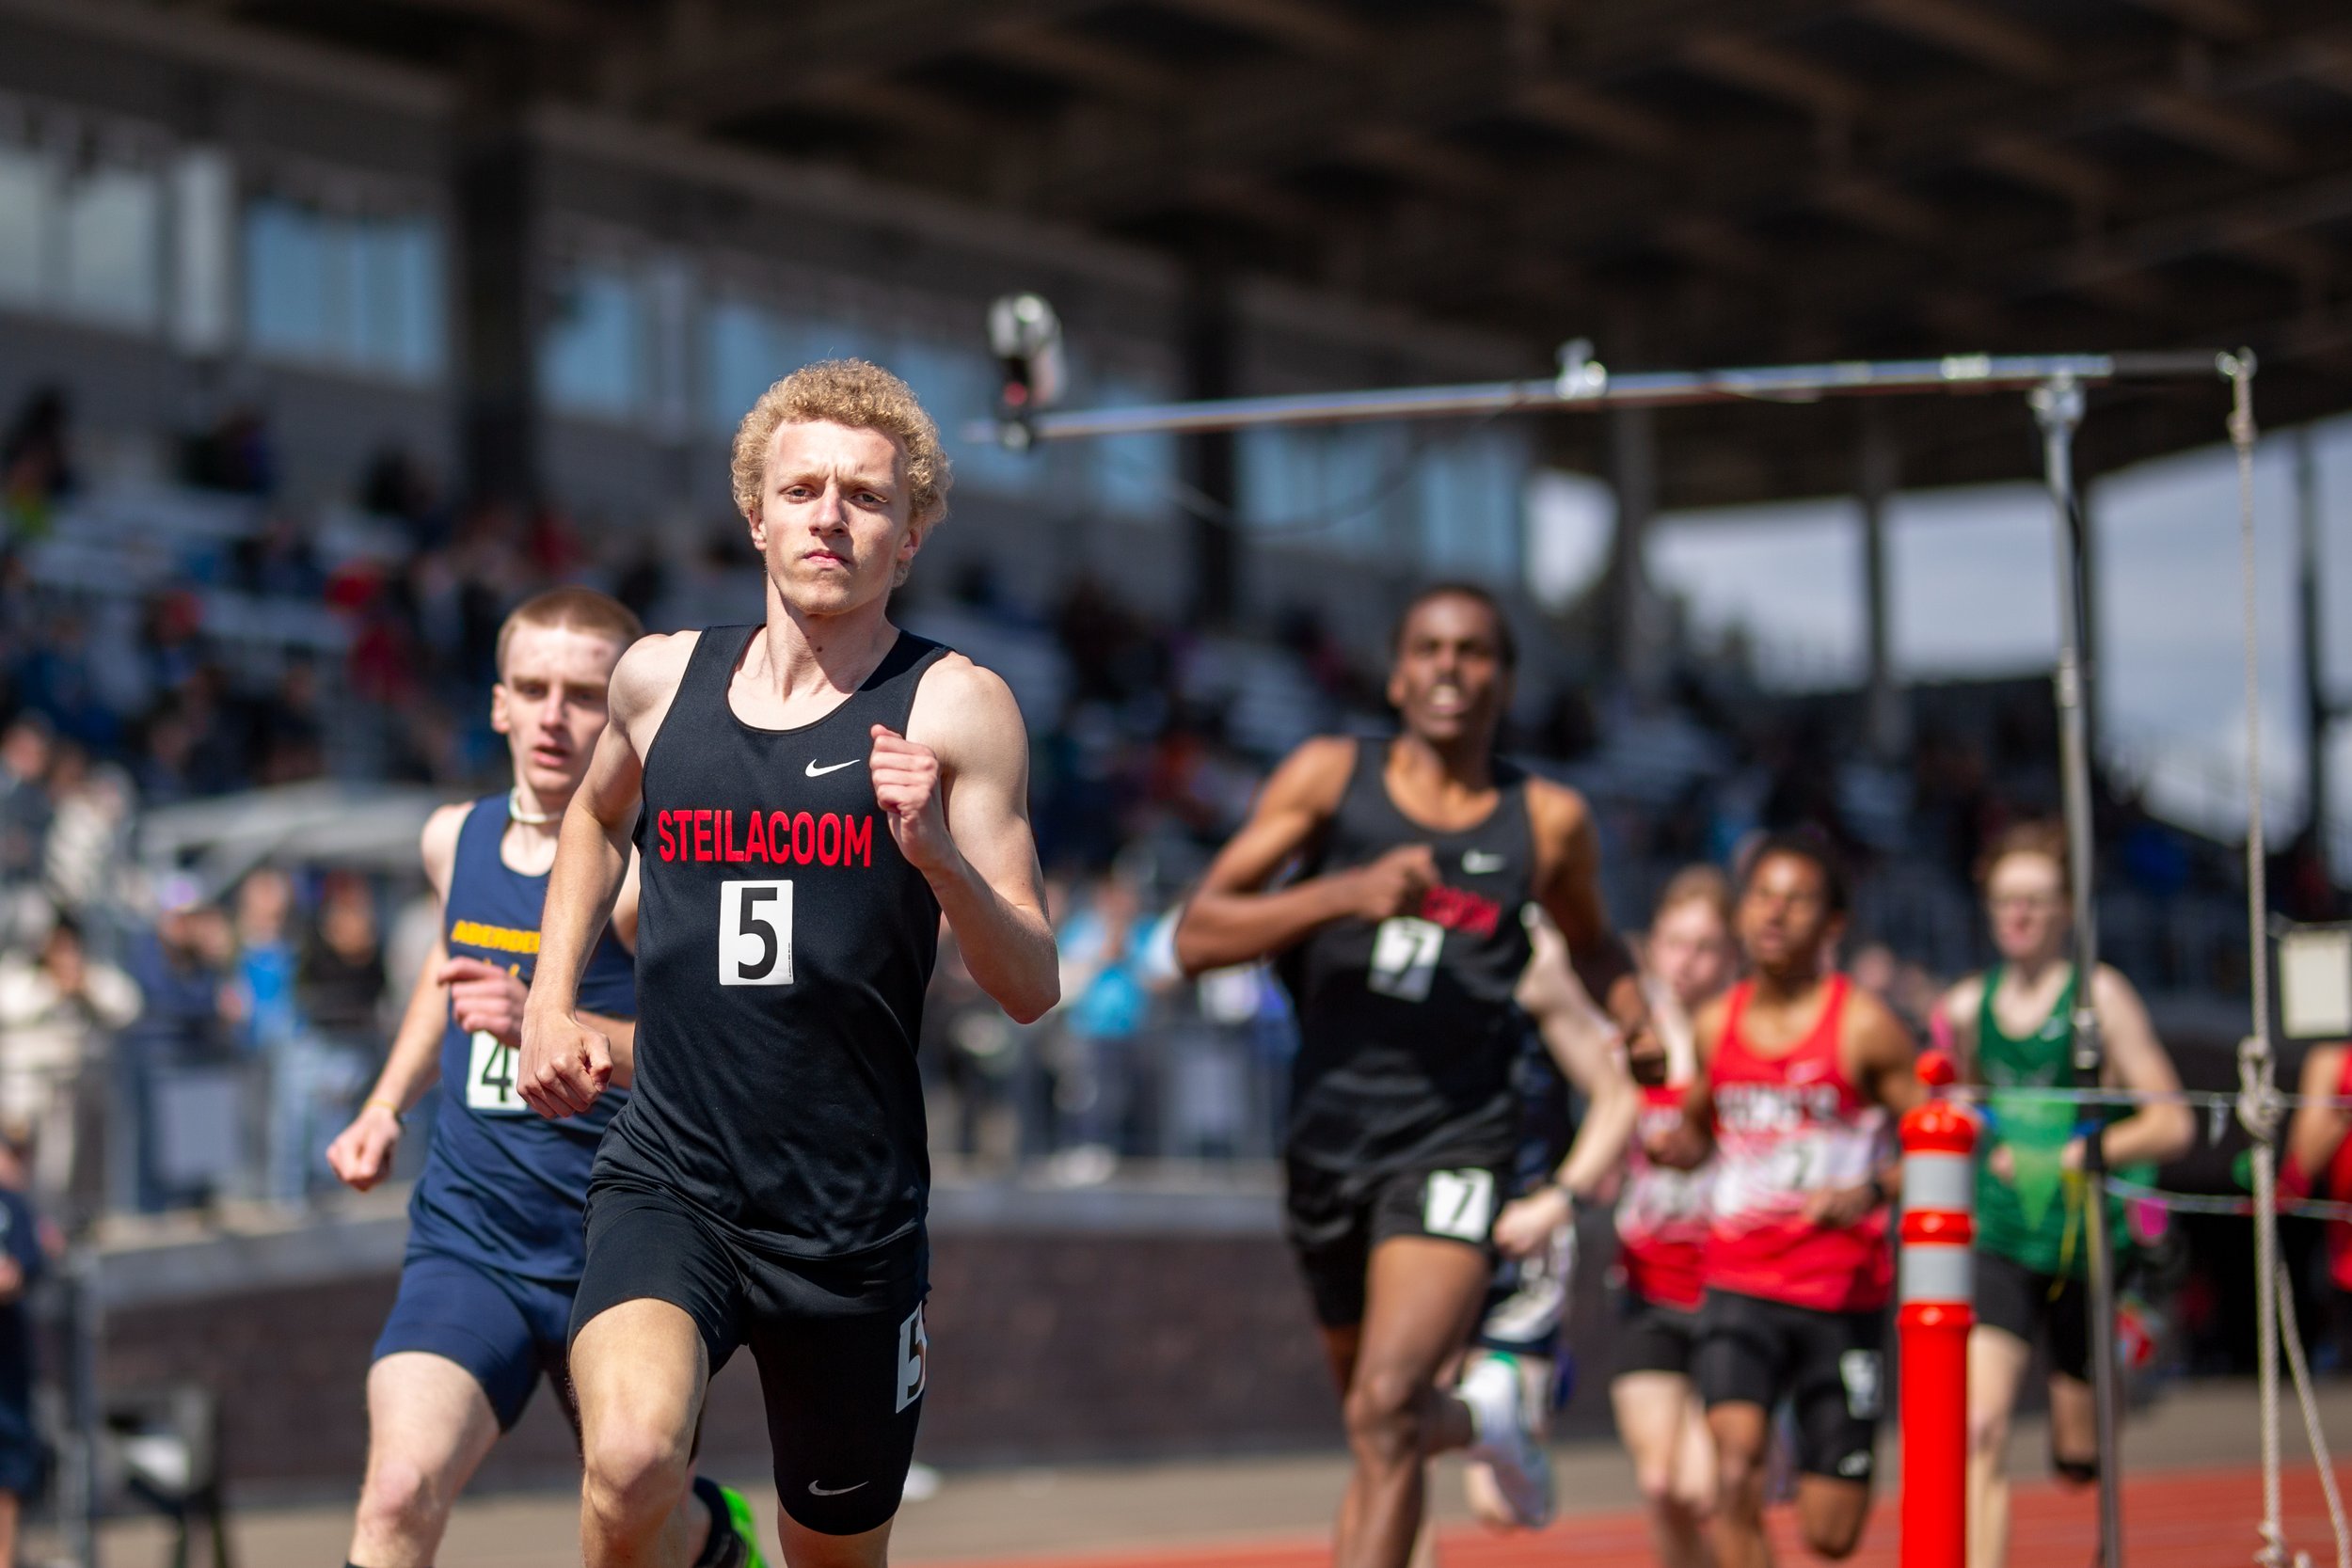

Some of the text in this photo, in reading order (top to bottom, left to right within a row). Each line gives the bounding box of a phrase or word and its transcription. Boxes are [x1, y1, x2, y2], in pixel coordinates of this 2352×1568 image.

[659, 809, 873, 868] STEILACOOM
[738, 886, 779, 980] 5
[1391, 924, 1425, 990] 7
[481, 1038, 512, 1102] 4
[906, 1306, 924, 1400] 5
